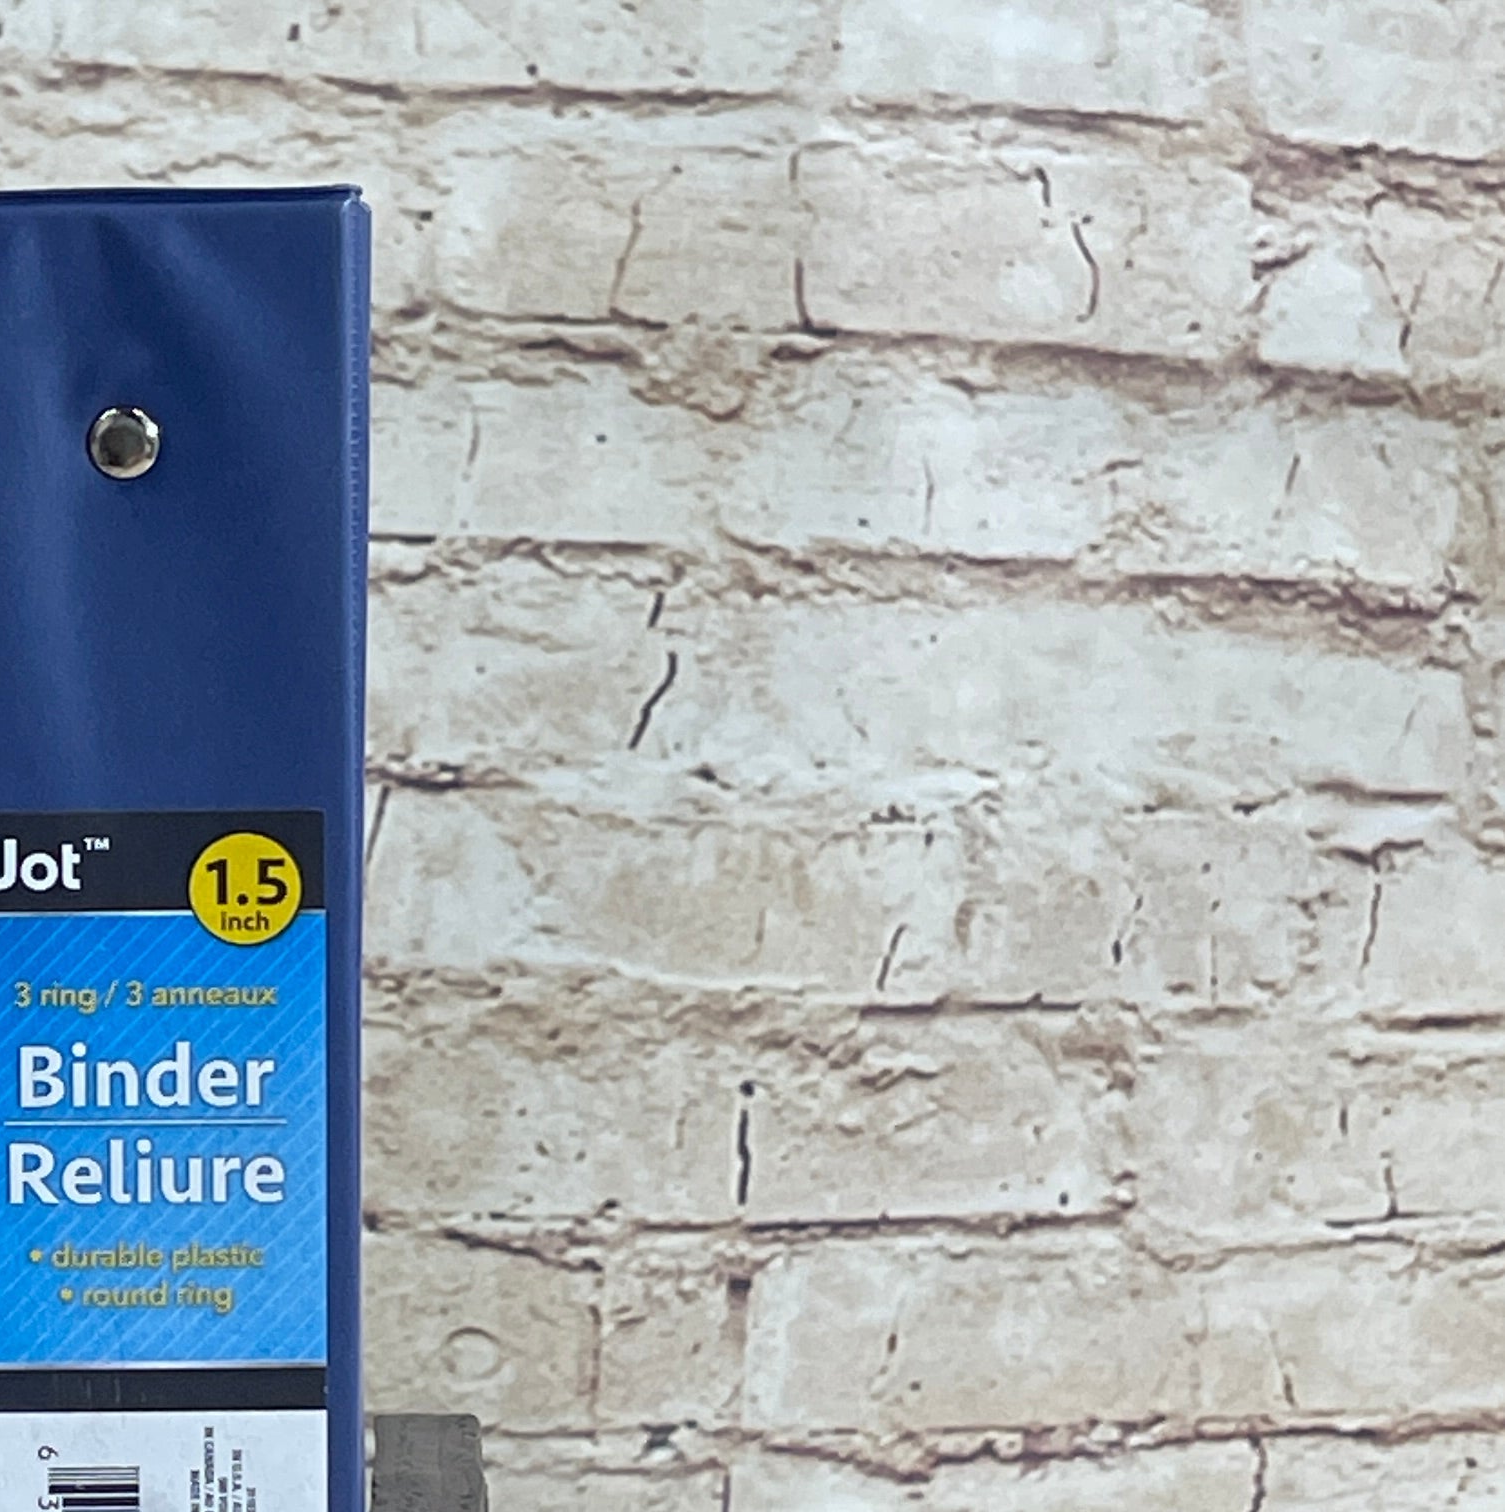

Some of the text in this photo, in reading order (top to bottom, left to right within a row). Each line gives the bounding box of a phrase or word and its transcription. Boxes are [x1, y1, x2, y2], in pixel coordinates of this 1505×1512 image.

[206, 858, 288, 907] 1.5
[14, 980, 32, 1008] 3
[40, 980, 96, 1014] ring
[125, 980, 142, 1007] 3
[152, 985, 278, 1006] anneaux
[18, 1041, 275, 1109] Binder
[8, 1139, 286, 1204] Reliure
[51, 1243, 265, 1275] durable plastic
[82, 1283, 233, 1313] round ring
[37, 1445, 59, 1461] 6
